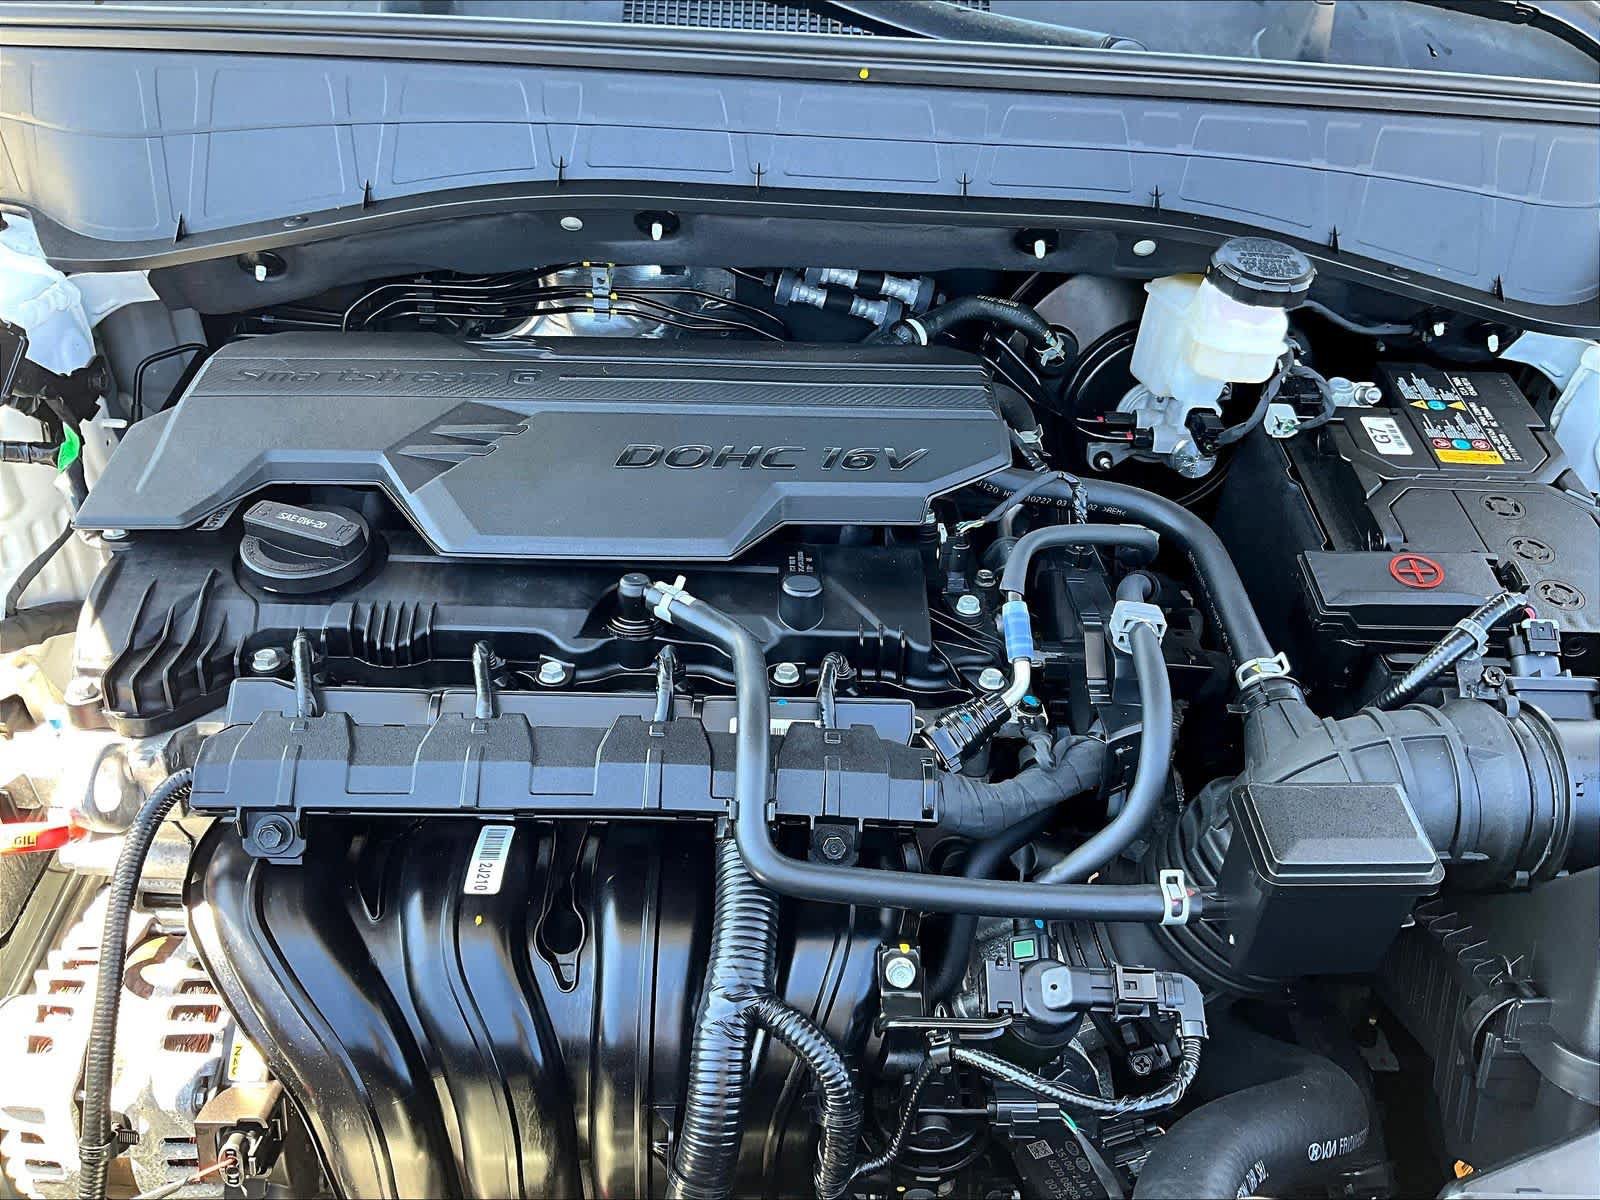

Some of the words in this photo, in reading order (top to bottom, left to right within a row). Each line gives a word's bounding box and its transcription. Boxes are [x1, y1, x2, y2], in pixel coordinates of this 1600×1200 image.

[1368, 427, 1391, 443] G7
[613, 443, 806, 470] DOHC
[820, 446, 930, 471] 16V
[279, 512, 299, 522] SAE
[297, 516, 328, 529] 0W-20
[474, 863, 493, 891] 2J210
